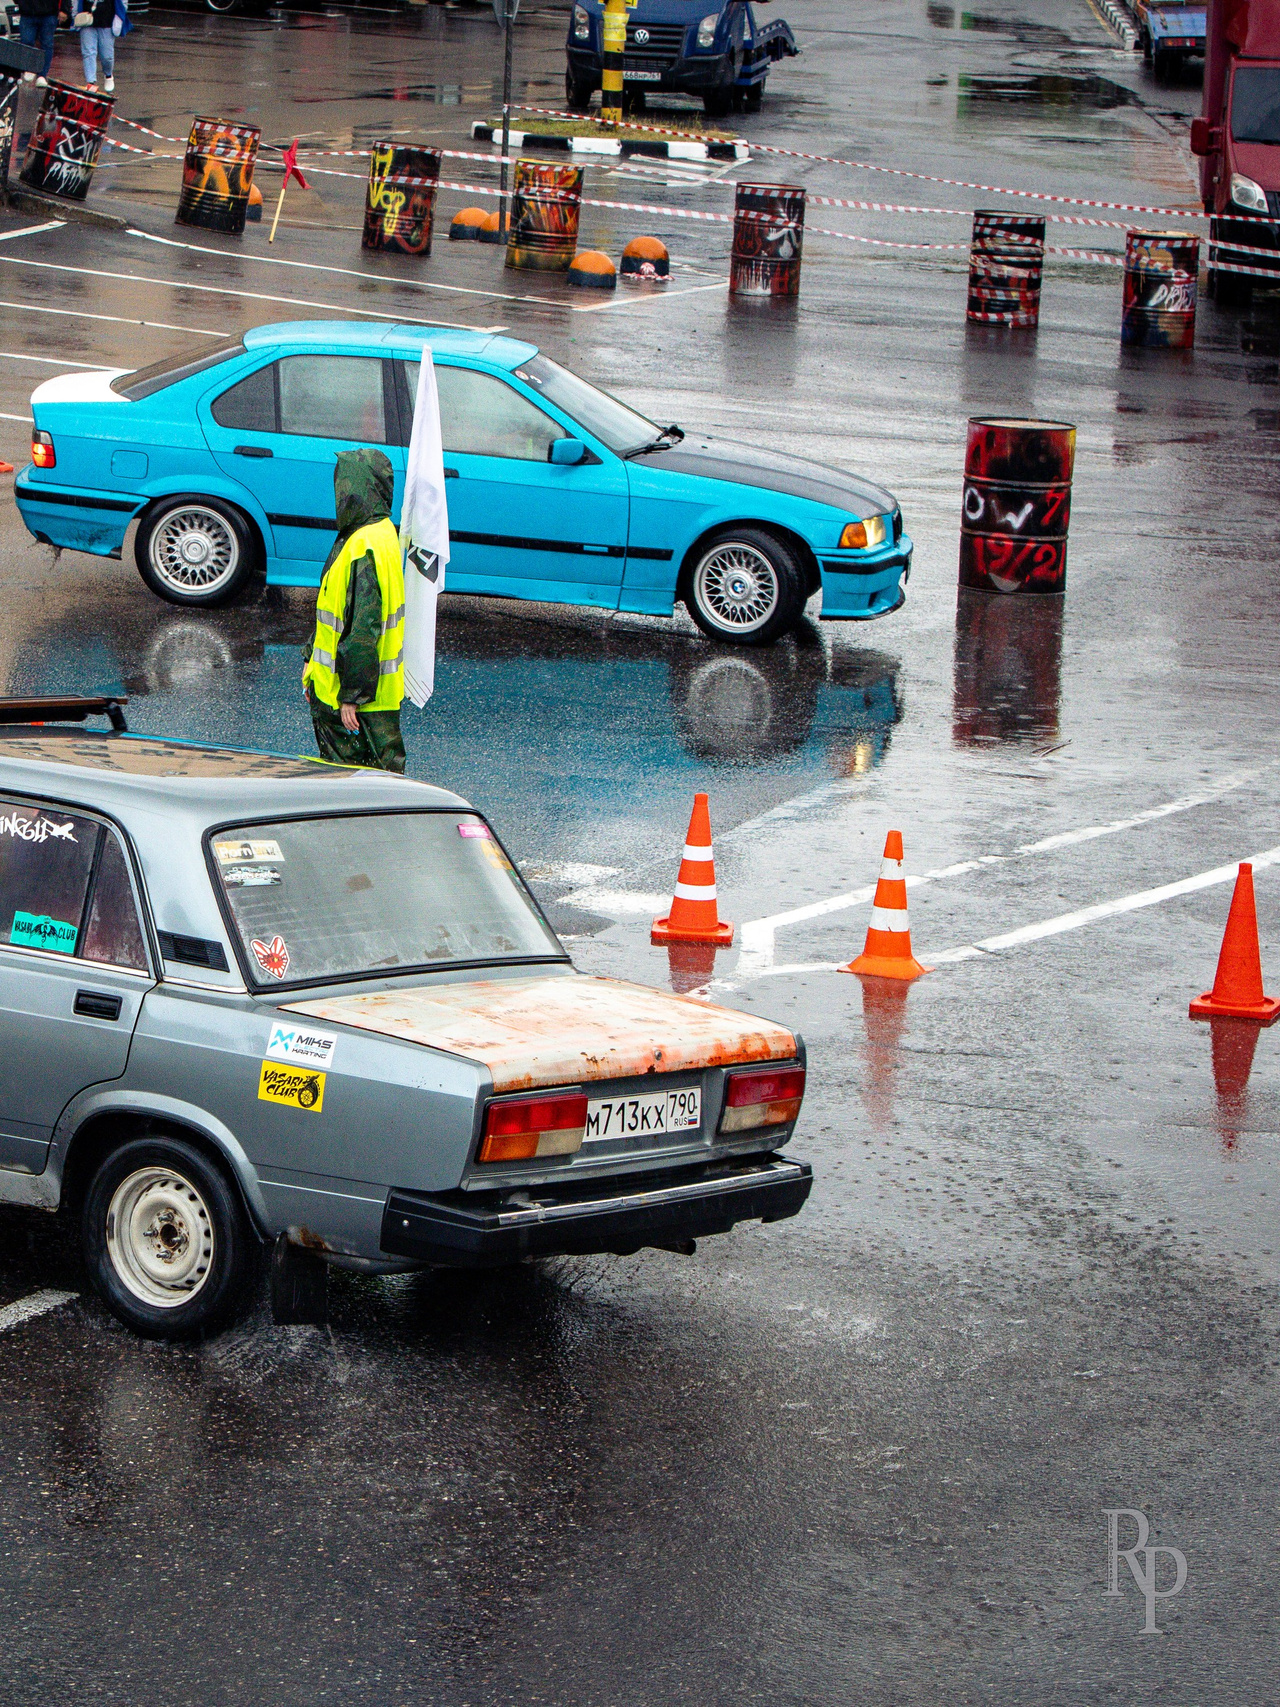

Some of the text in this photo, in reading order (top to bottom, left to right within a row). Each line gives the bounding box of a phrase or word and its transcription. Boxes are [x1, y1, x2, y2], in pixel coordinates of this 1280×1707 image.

[58, 927, 76, 941] CLUB
[296, 1035, 333, 1049] MIKS
[266, 1084, 298, 1098] CLUB
[669, 1092, 696, 1118] 790
[674, 1117, 688, 1127] RUS
